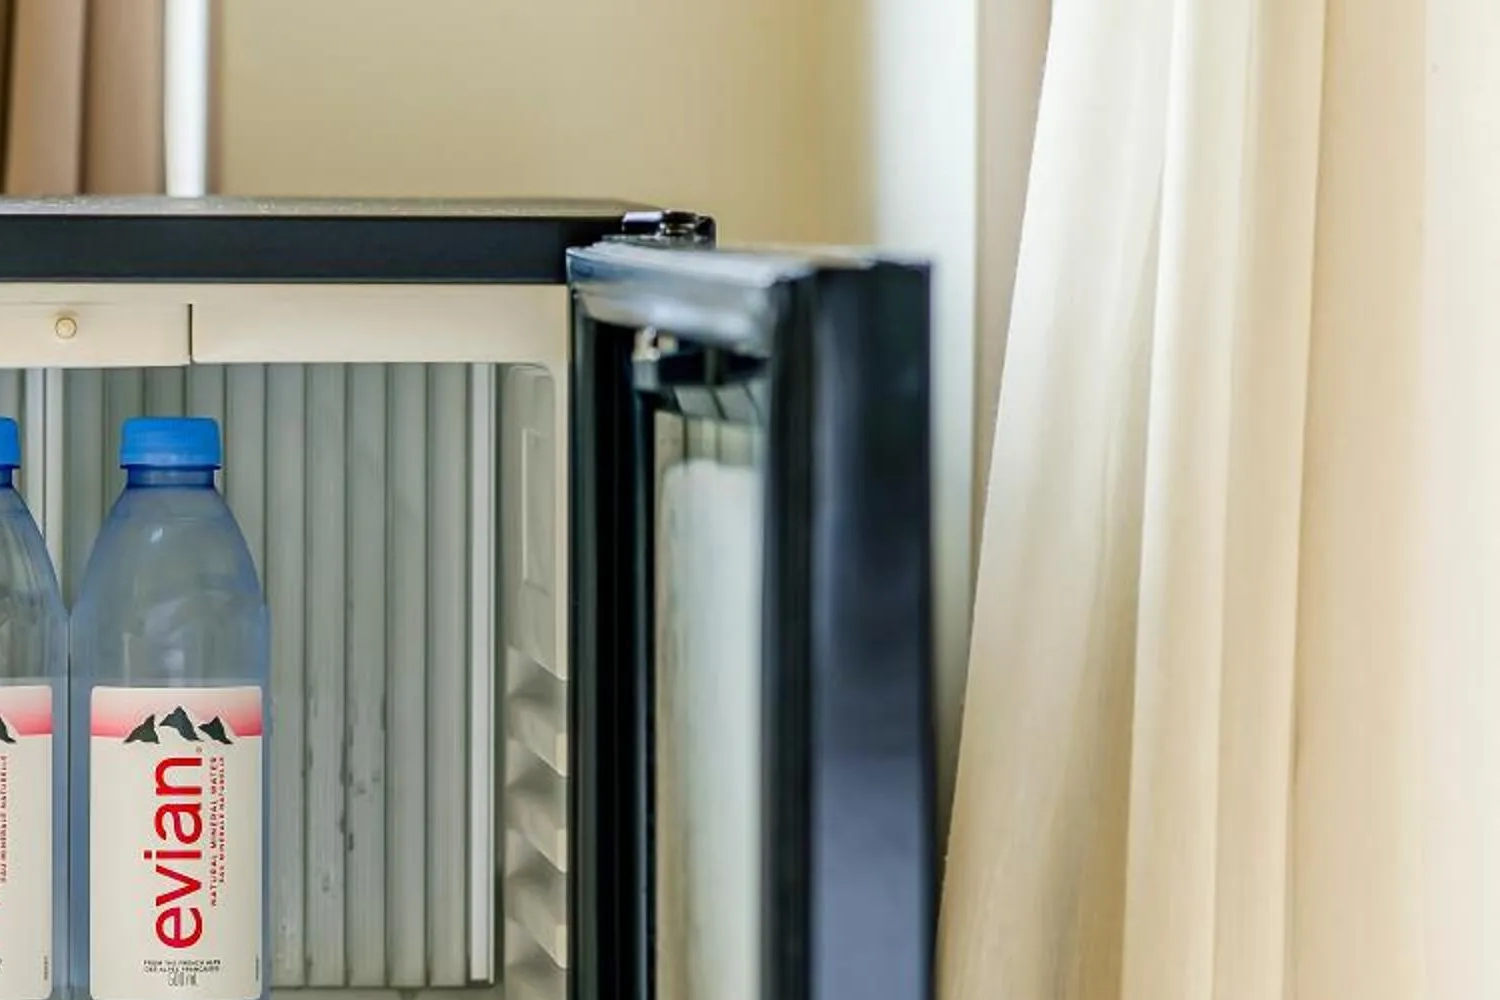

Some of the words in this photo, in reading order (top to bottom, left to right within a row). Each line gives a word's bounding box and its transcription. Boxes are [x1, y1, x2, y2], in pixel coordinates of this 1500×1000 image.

[209, 756, 218, 795] WATER
[209, 801, 218, 849] MINERAL
[144, 756, 202, 948] evian
[209, 855, 218, 907] NATURAL
